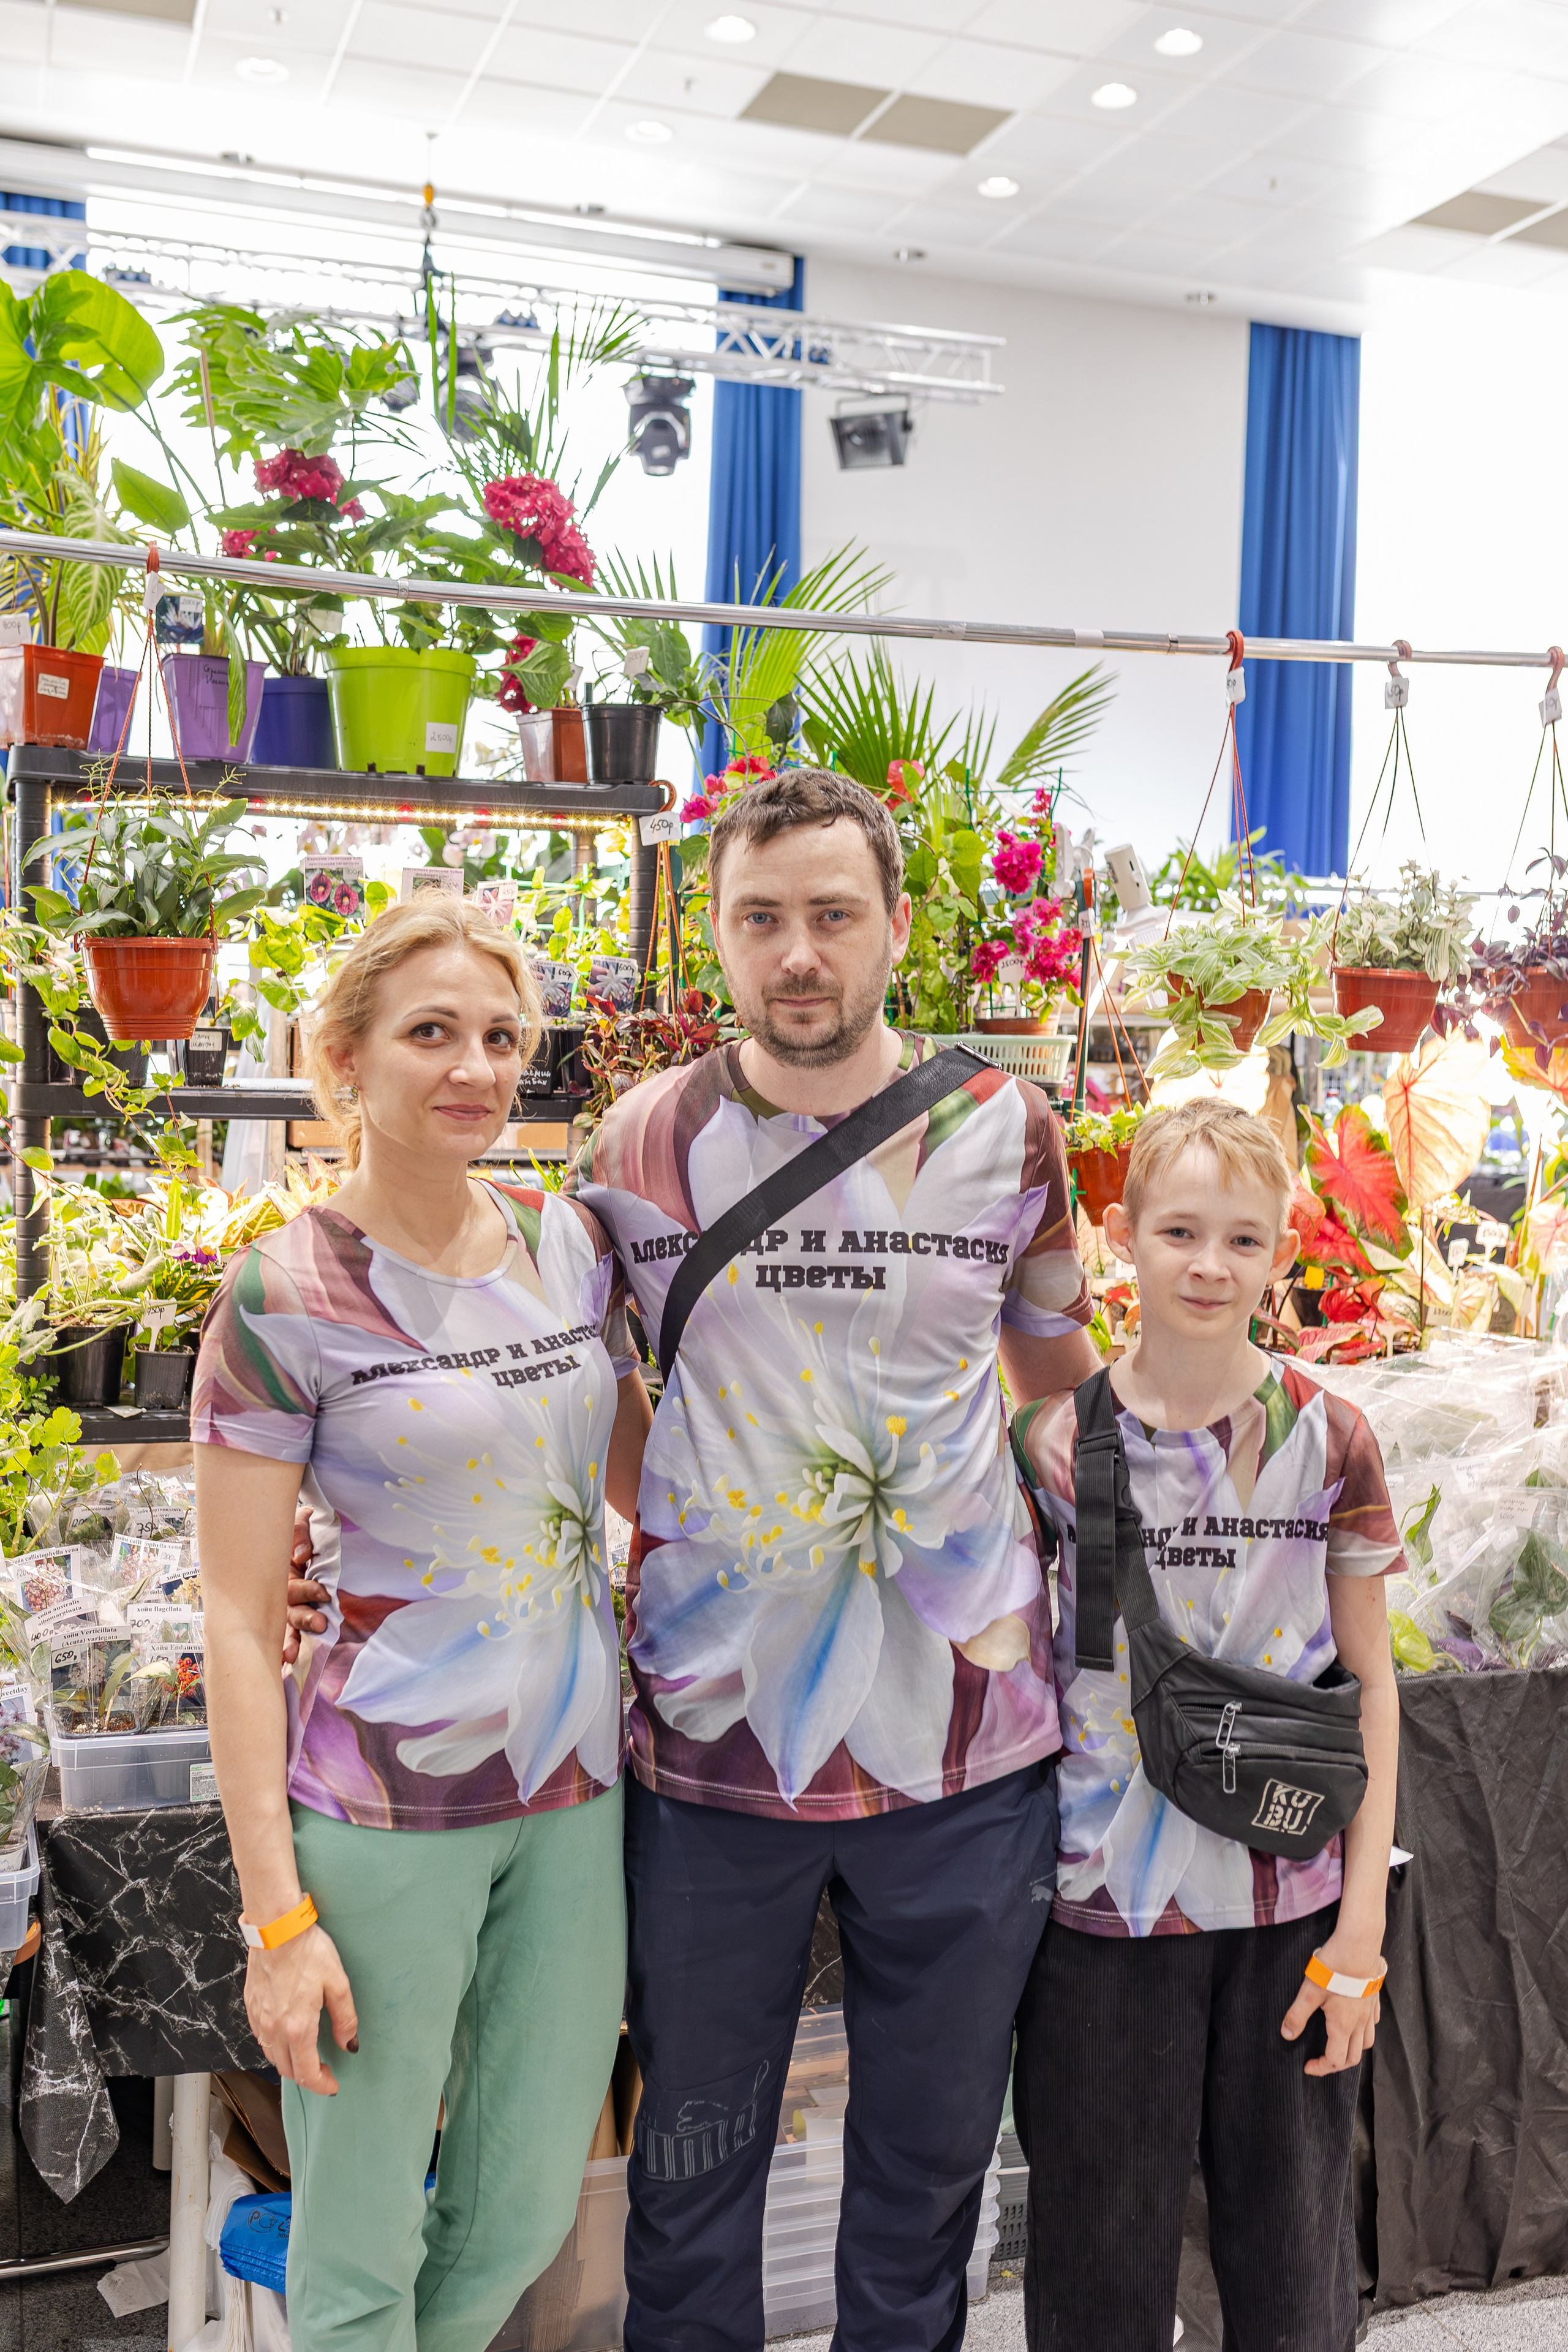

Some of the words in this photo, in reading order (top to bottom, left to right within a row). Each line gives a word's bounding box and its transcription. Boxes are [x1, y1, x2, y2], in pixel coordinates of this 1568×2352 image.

[650, 818, 674, 835] 450р
[630, 1229, 789, 1264] Алексдр
[129, 1539, 167, 1549] calliophylla
[24, 1550, 64, 1562] callistophylla
[53, 1599, 80, 1612] australis
[37, 1606, 83, 1627] albomarginata
[80, 1627, 117, 1636] Verticillata
[62, 1638, 86, 1647] (Acuta)
